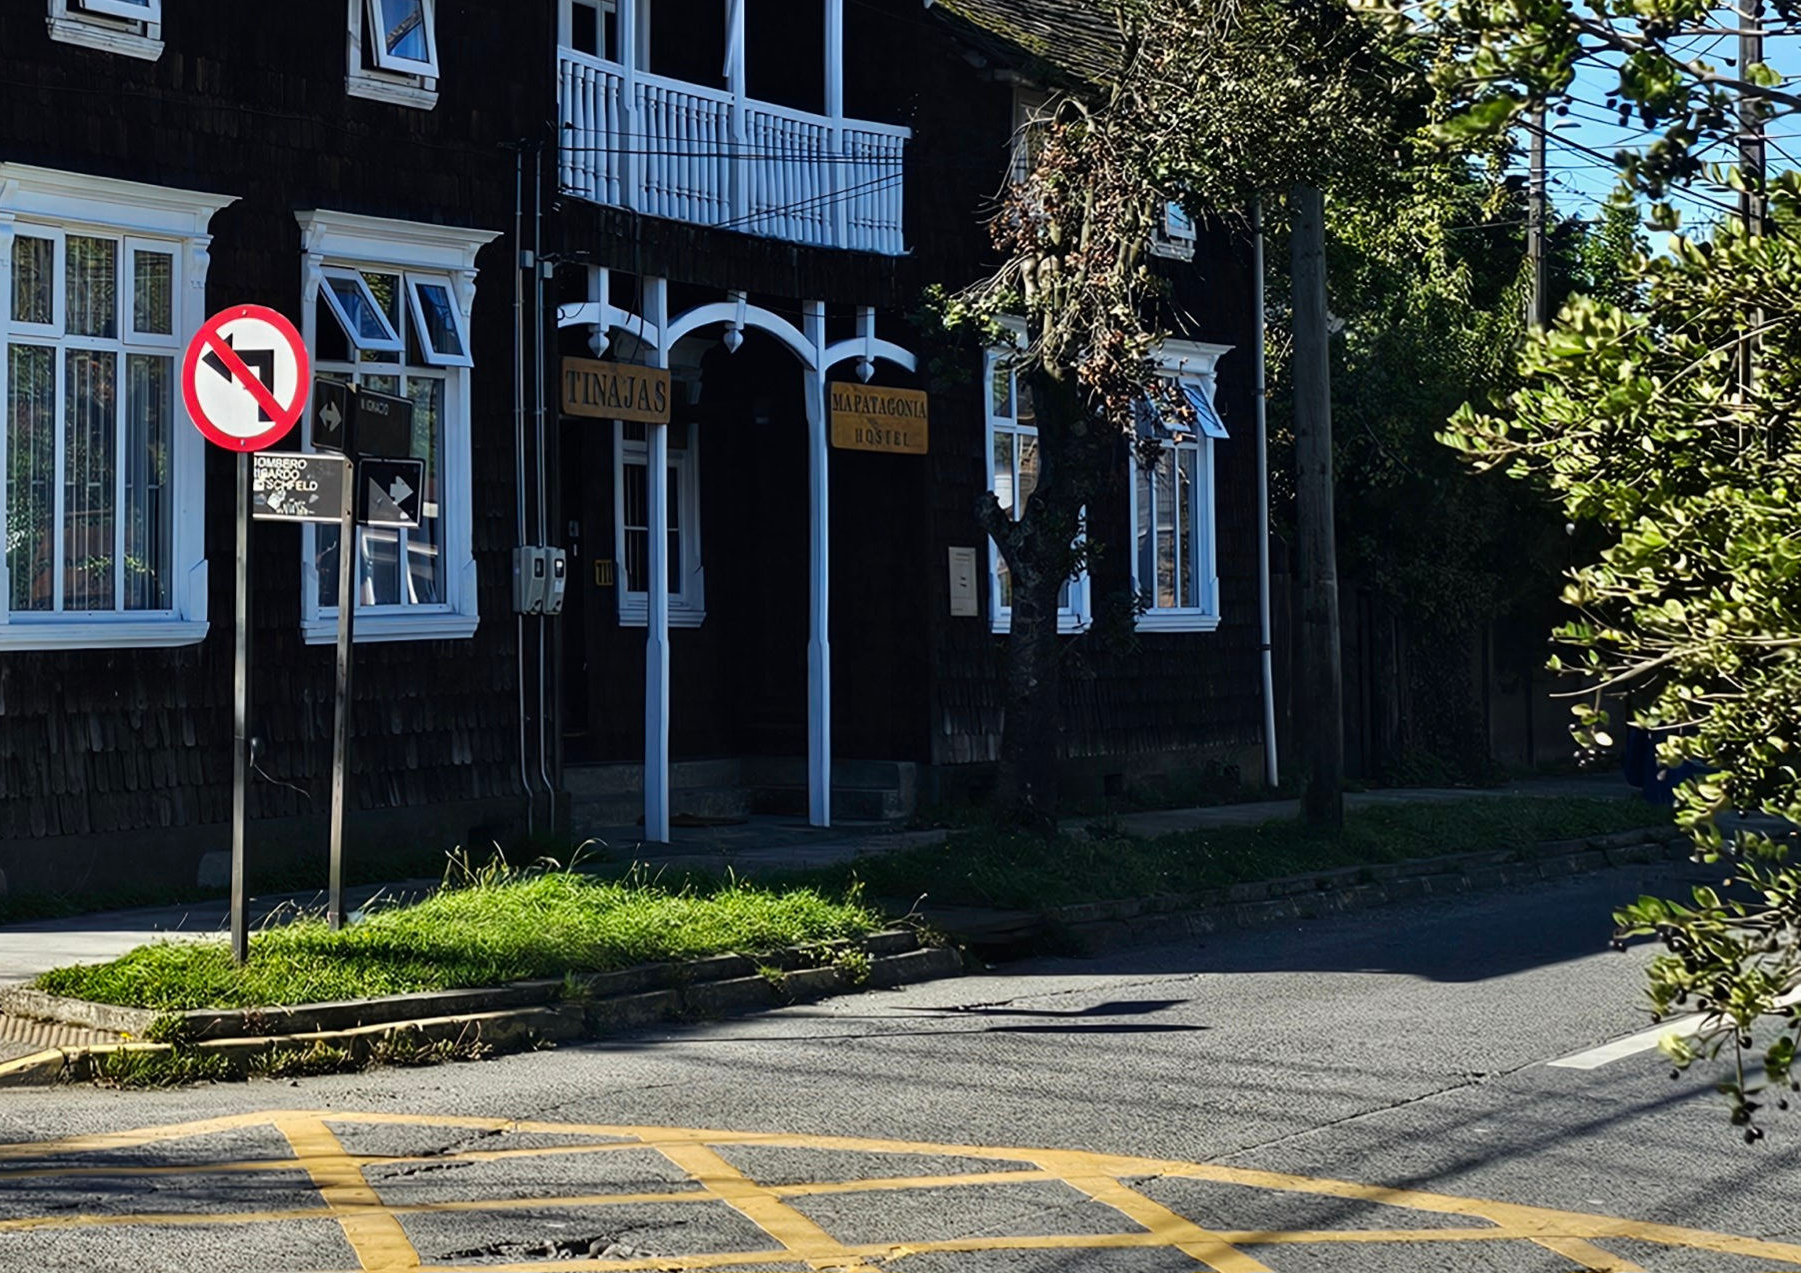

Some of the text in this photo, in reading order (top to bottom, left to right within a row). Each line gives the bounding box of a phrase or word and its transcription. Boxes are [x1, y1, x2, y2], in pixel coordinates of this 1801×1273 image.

[566, 369, 666, 413] TINAJAS
[832, 393, 927, 419] MAPATAGONIA
[855, 428, 911, 447] HOSTEL
